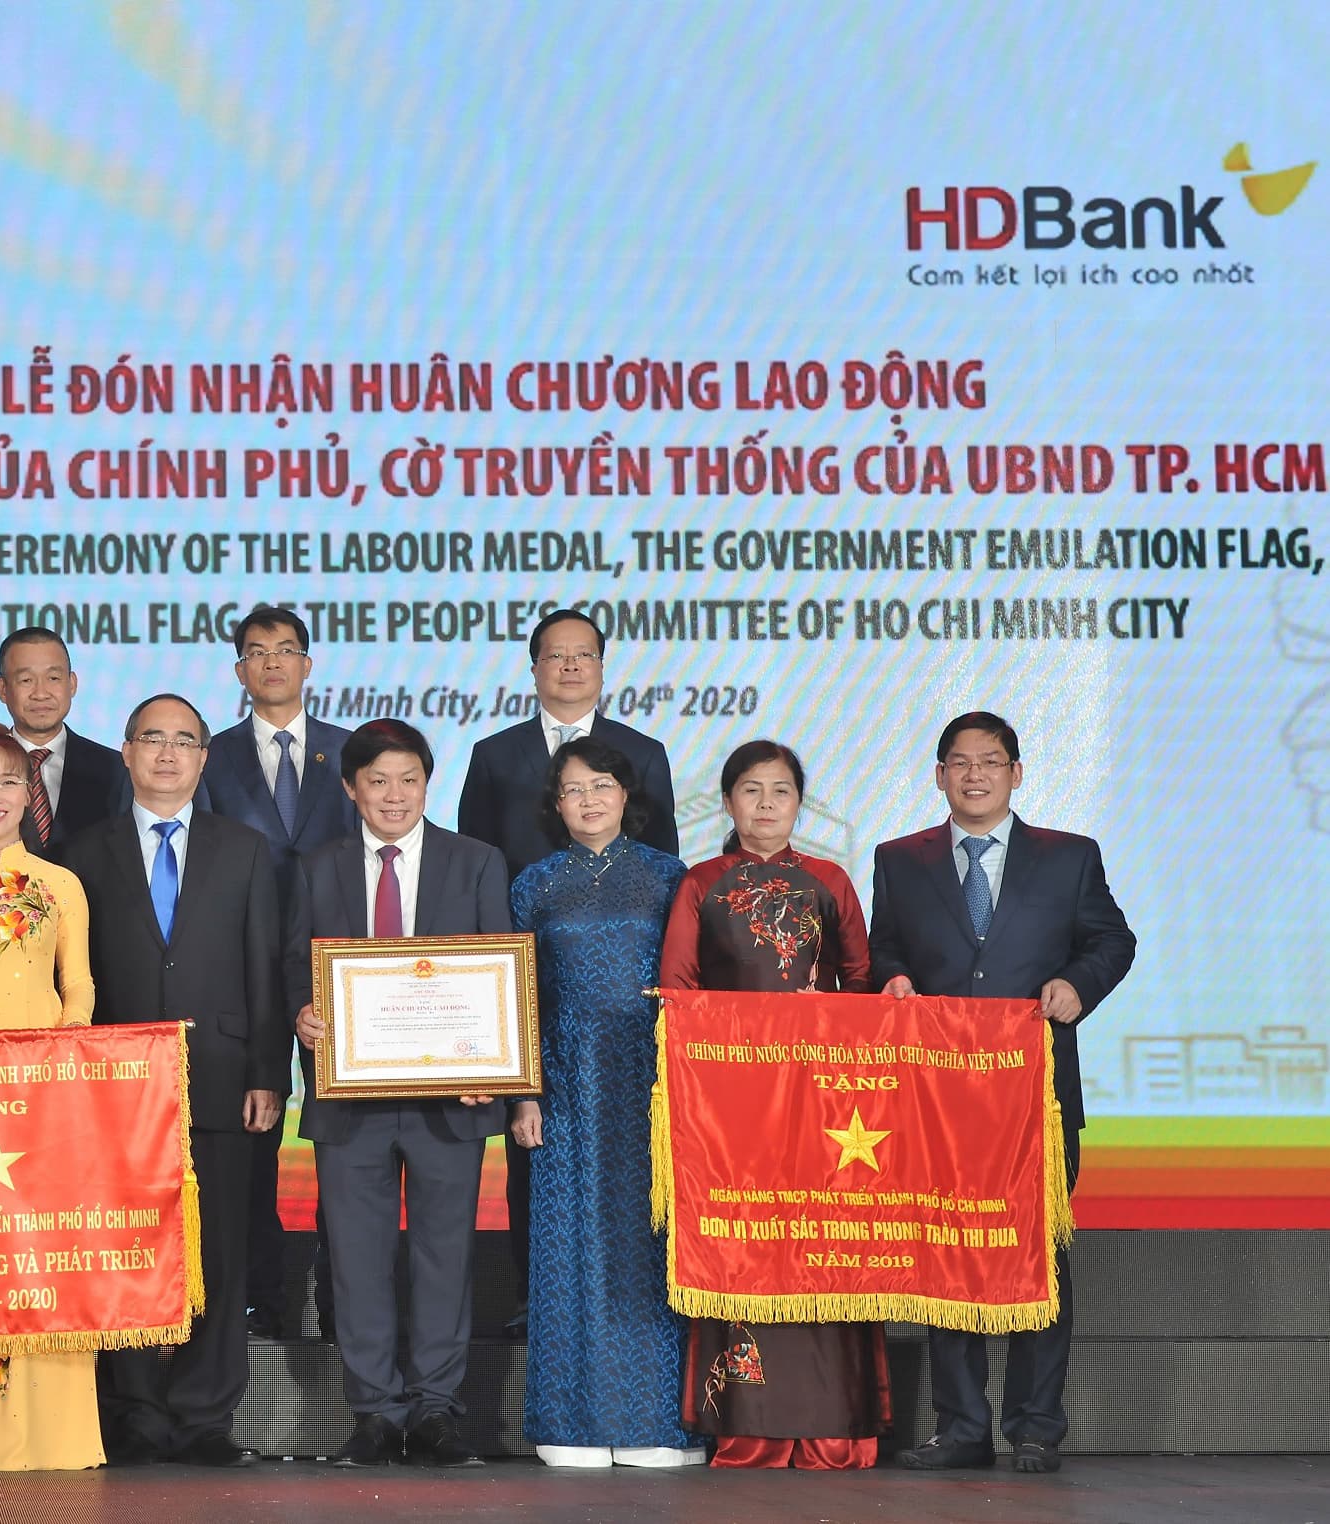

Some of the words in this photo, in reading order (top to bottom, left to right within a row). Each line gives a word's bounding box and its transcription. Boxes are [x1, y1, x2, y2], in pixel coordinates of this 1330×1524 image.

[905, 185, 1226, 251] HDBank
[906, 264, 964, 287] Cam
[1131, 267, 1179, 285] cao
[2, 345, 54, 414] LỄ
[65, 353, 174, 414] ĐÓN
[190, 353, 334, 428] NHẬN
[350, 352, 493, 413] HUÂN
[506, 354, 721, 412] CHƯƠNG
[734, 360, 829, 411] LAO
[839, 350, 987, 425] ĐỘNG
[67, 438, 227, 499] CHÍNH
[244, 432, 367, 507] PHỦ,
[380, 437, 446, 498] CỜ
[454, 430, 651, 497] TRUYỀN
[663, 428, 841, 497] THỐNG
[853, 430, 954, 496] CỦA
[967, 444, 1115, 495] UBND
[1124, 444, 1201, 494] TP.
[1213, 442, 1328, 493] HCM
[182, 532, 231, 574] OF
[238, 532, 312, 574] THE
[320, 531, 474, 574] LABOUR
[482, 530, 624, 579] MEDAL,
[631, 530, 705, 572] THE
[713, 529, 978, 572] GOVERNMENT
[986, 527, 1207, 571] EMULATION
[1217, 527, 1325, 576] FLAG,
[149, 602, 241, 643] FLAG
[305, 601, 377, 643] THE
[797, 599, 845, 641] OF
[854, 598, 910, 641] HO
[917, 598, 981, 641] CHI
[991, 598, 1098, 640] MINH
[1107, 597, 1190, 640] CITY
[335, 685, 413, 718] Minh
[420, 685, 482, 726] City,
[685, 685, 758, 717] 2020
[23, 1056, 53, 1082] PHỐ
[56, 1053, 76, 1081] HỒ
[81, 1057, 107, 1080] CHÍ
[112, 1060, 150, 1080] MINH
[686, 1039, 725, 1062] CHÍNH
[728, 1039, 753, 1063] PHỦ
[756, 1041, 790, 1064] NƯỚC
[793, 1040, 826, 1066] CỘNG
[829, 1042, 855, 1064] HÒA
[856, 1043, 873, 1064] XÃ
[875, 1041, 897, 1068] HỘI
[899, 1041, 924, 1064] CHỦ
[926, 1048, 965, 1070] NGHĨA
[967, 1048, 995, 1074] VIỆT
[997, 1049, 1025, 1070] NAM
[813, 1073, 900, 1093] TẶNG
[709, 1185, 741, 1203] NGÂN
[743, 1185, 775, 1203] HÀNG
[777, 1190, 807, 1204] TMCP
[811, 1187, 839, 1205] PHÁT
[842, 1185, 875, 1206] TRIỂN
[877, 1189, 914, 1206] THÀNH
[916, 1187, 940, 1209] PHỐ
[941, 1191, 956, 1211] HỒ
[957, 1196, 976, 1213] CHÍ
[977, 1199, 1006, 1213] MINH
[14, 1209, 54, 1232] THÀNH
[58, 1204, 83, 1230] PHỐ
[86, 1203, 102, 1229] HỒ
[106, 1206, 126, 1229] CHÍ
[129, 1208, 160, 1228] MINH
[700, 1216, 730, 1238] ĐƠN
[733, 1220, 747, 1244] VỊ
[750, 1214, 785, 1240] XUẤT
[790, 1214, 818, 1239] SẮC
[822, 1221, 870, 1241] TRONG
[873, 1221, 921, 1241] PHONG
[925, 1222, 959, 1246] TRÀO
[962, 1228, 984, 1248] THI
[988, 1227, 1018, 1248] ĐUA
[14, 1248, 39, 1274] VÀ
[45, 1245, 94, 1272] PHÁT
[99, 1237, 156, 1271] TRIỂN
[806, 1250, 861, 1268] NĂM
[867, 1255, 915, 1268] 2019
[7, 1286, 58, 1312] 2020)
